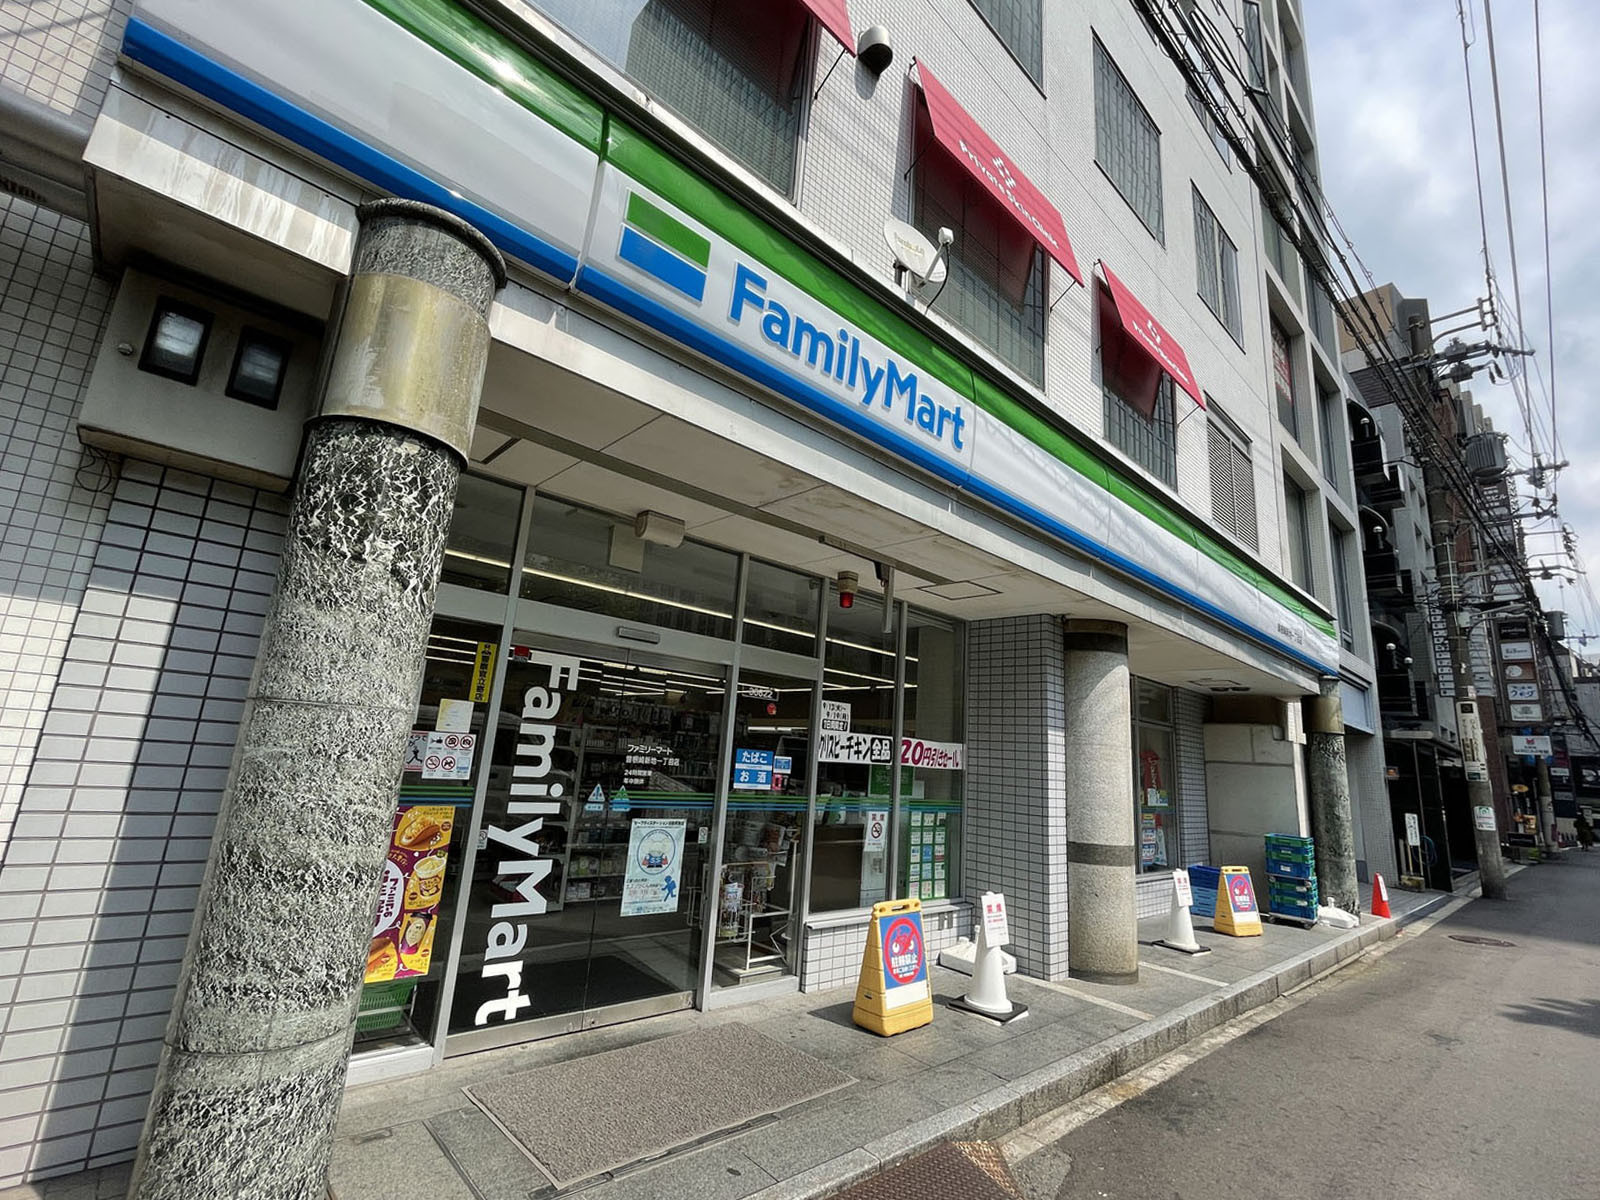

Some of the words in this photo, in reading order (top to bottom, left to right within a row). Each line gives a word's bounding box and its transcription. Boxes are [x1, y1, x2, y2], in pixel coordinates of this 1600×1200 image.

[729, 262, 966, 450] FamilyMart
[628, 744, 673, 755] ファミリーマート
[742, 751, 768, 764] たばこ
[739, 770, 767, 783] お酒
[475, 651, 580, 1026] FamilyMart
